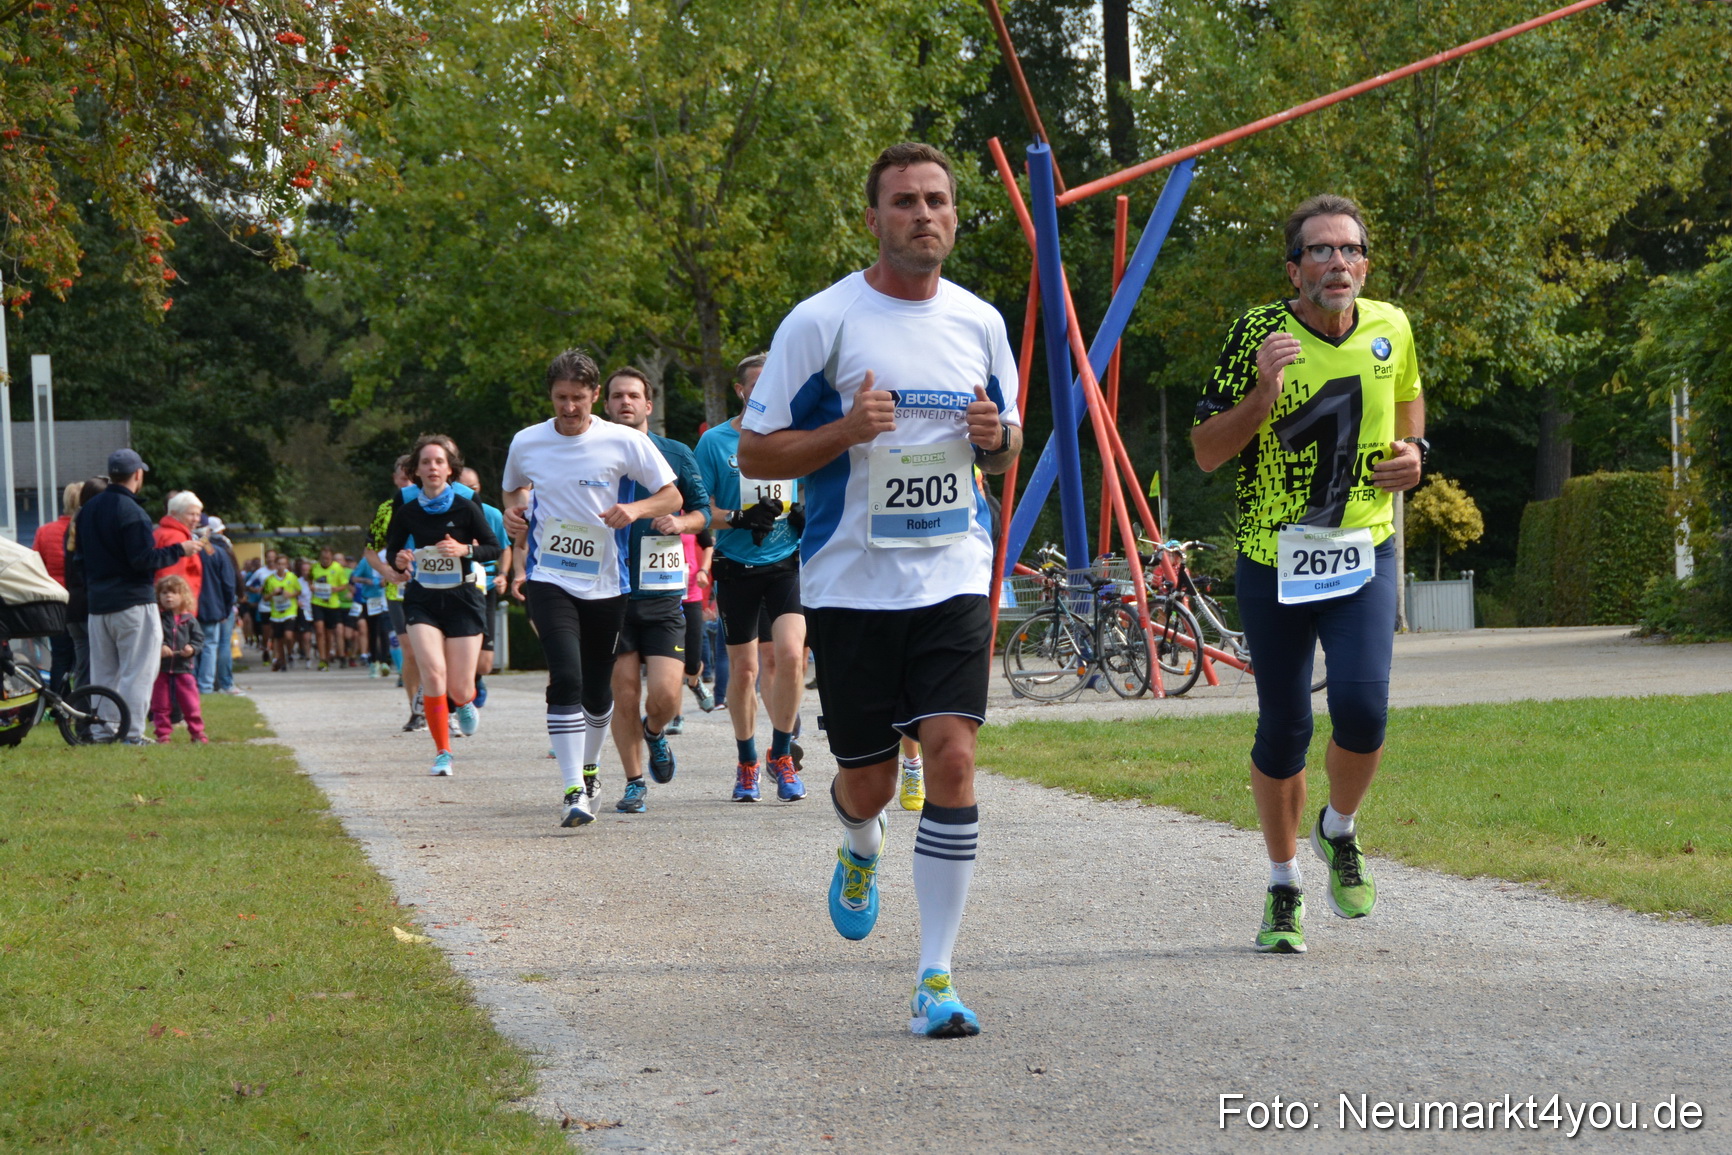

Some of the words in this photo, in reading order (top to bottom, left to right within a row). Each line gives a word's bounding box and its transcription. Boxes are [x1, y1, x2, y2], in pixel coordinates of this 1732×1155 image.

[912, 452, 946, 463] BOCK
[754, 484, 782, 501] 118
[886, 473, 958, 508] 2503
[907, 517, 941, 530] Robert
[550, 535, 595, 557] 2306
[421, 558, 454, 572] 2929
[561, 559, 578, 568] Peter
[649, 552, 680, 569] 2136
[1292, 546, 1361, 576] 2679
[1314, 579, 1341, 590] Claus
